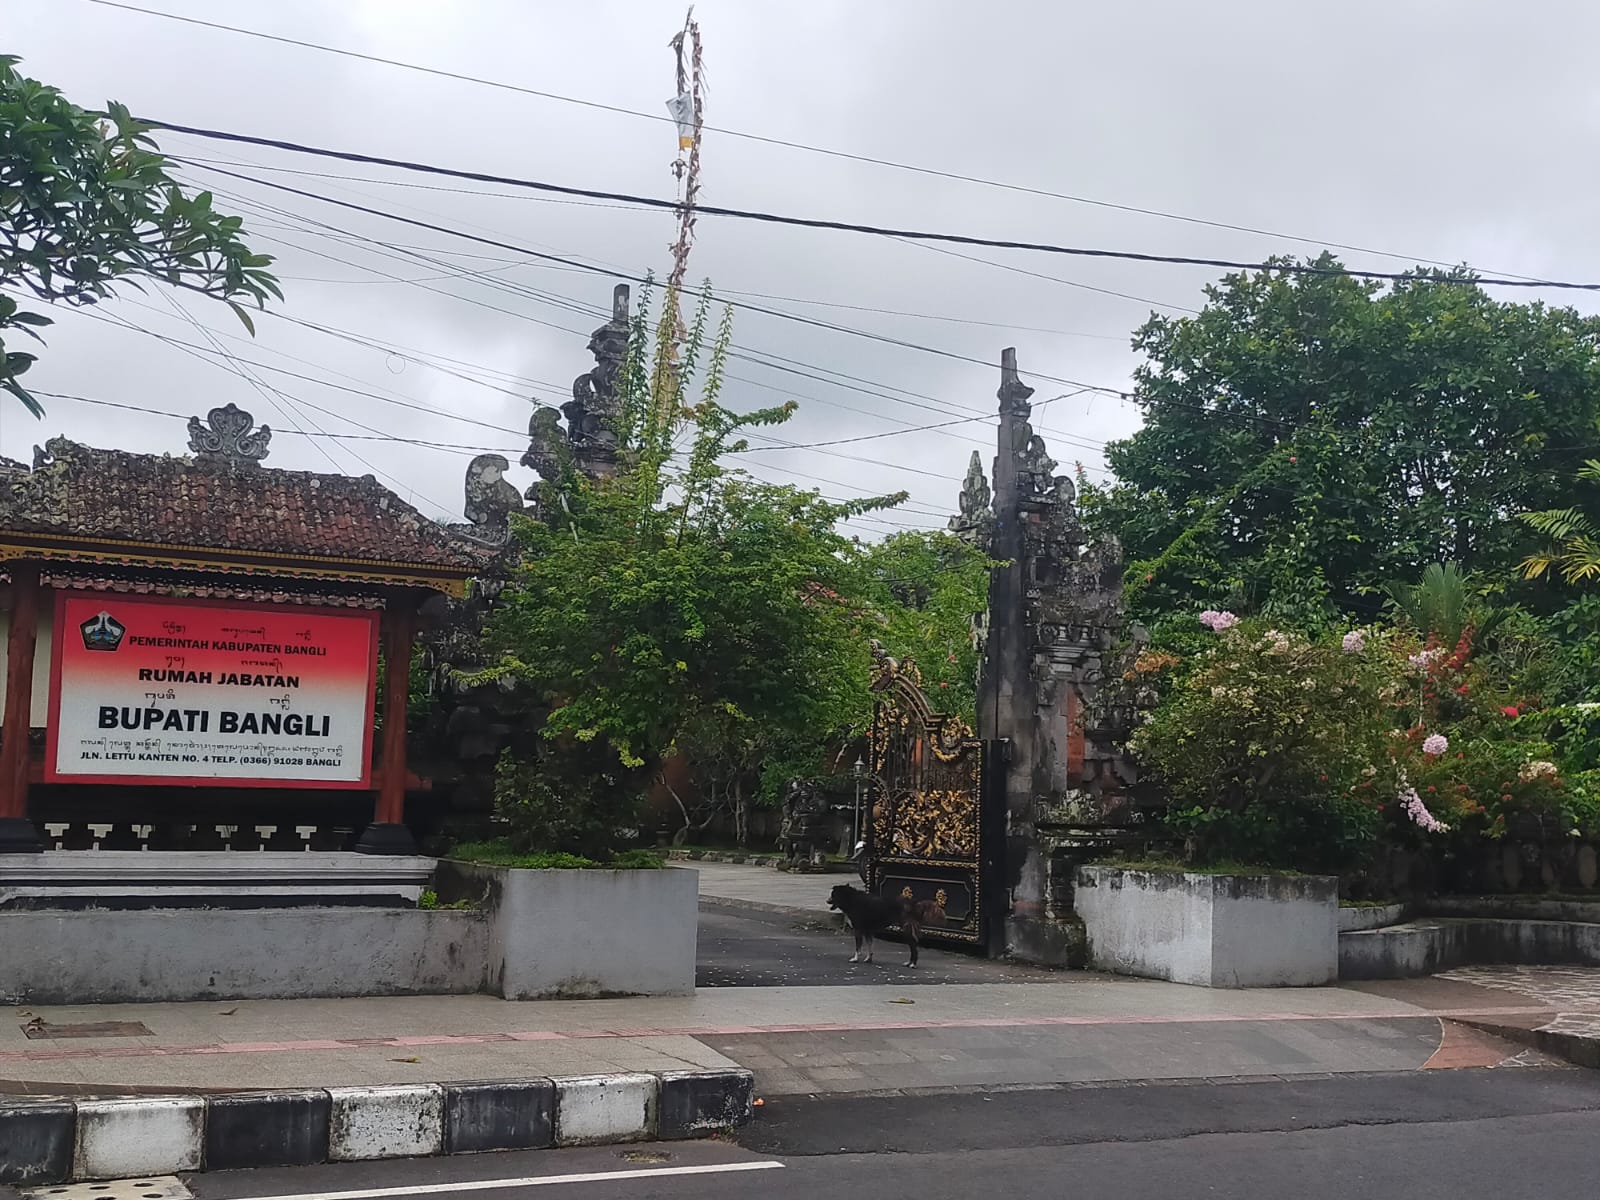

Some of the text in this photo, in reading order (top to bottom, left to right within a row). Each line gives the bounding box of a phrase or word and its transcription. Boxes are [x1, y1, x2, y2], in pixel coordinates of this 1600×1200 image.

[129, 635, 327, 656] PEMERINTAH KABUPATEN BANGLI
[139, 668, 299, 688] RUMAH JABATAN
[98, 706, 331, 737] BUPATI BANGLI
[80, 751, 102, 760] JLN.
[105, 752, 136, 761] LETTU
[138, 753, 179, 762] KANTEN
[182, 754, 200, 763] NO.
[211, 755, 238, 764] TELP.
[240, 756, 272, 766] (0366)
[273, 757, 304, 766] 91028
[306, 758, 341, 767] BANGLI
